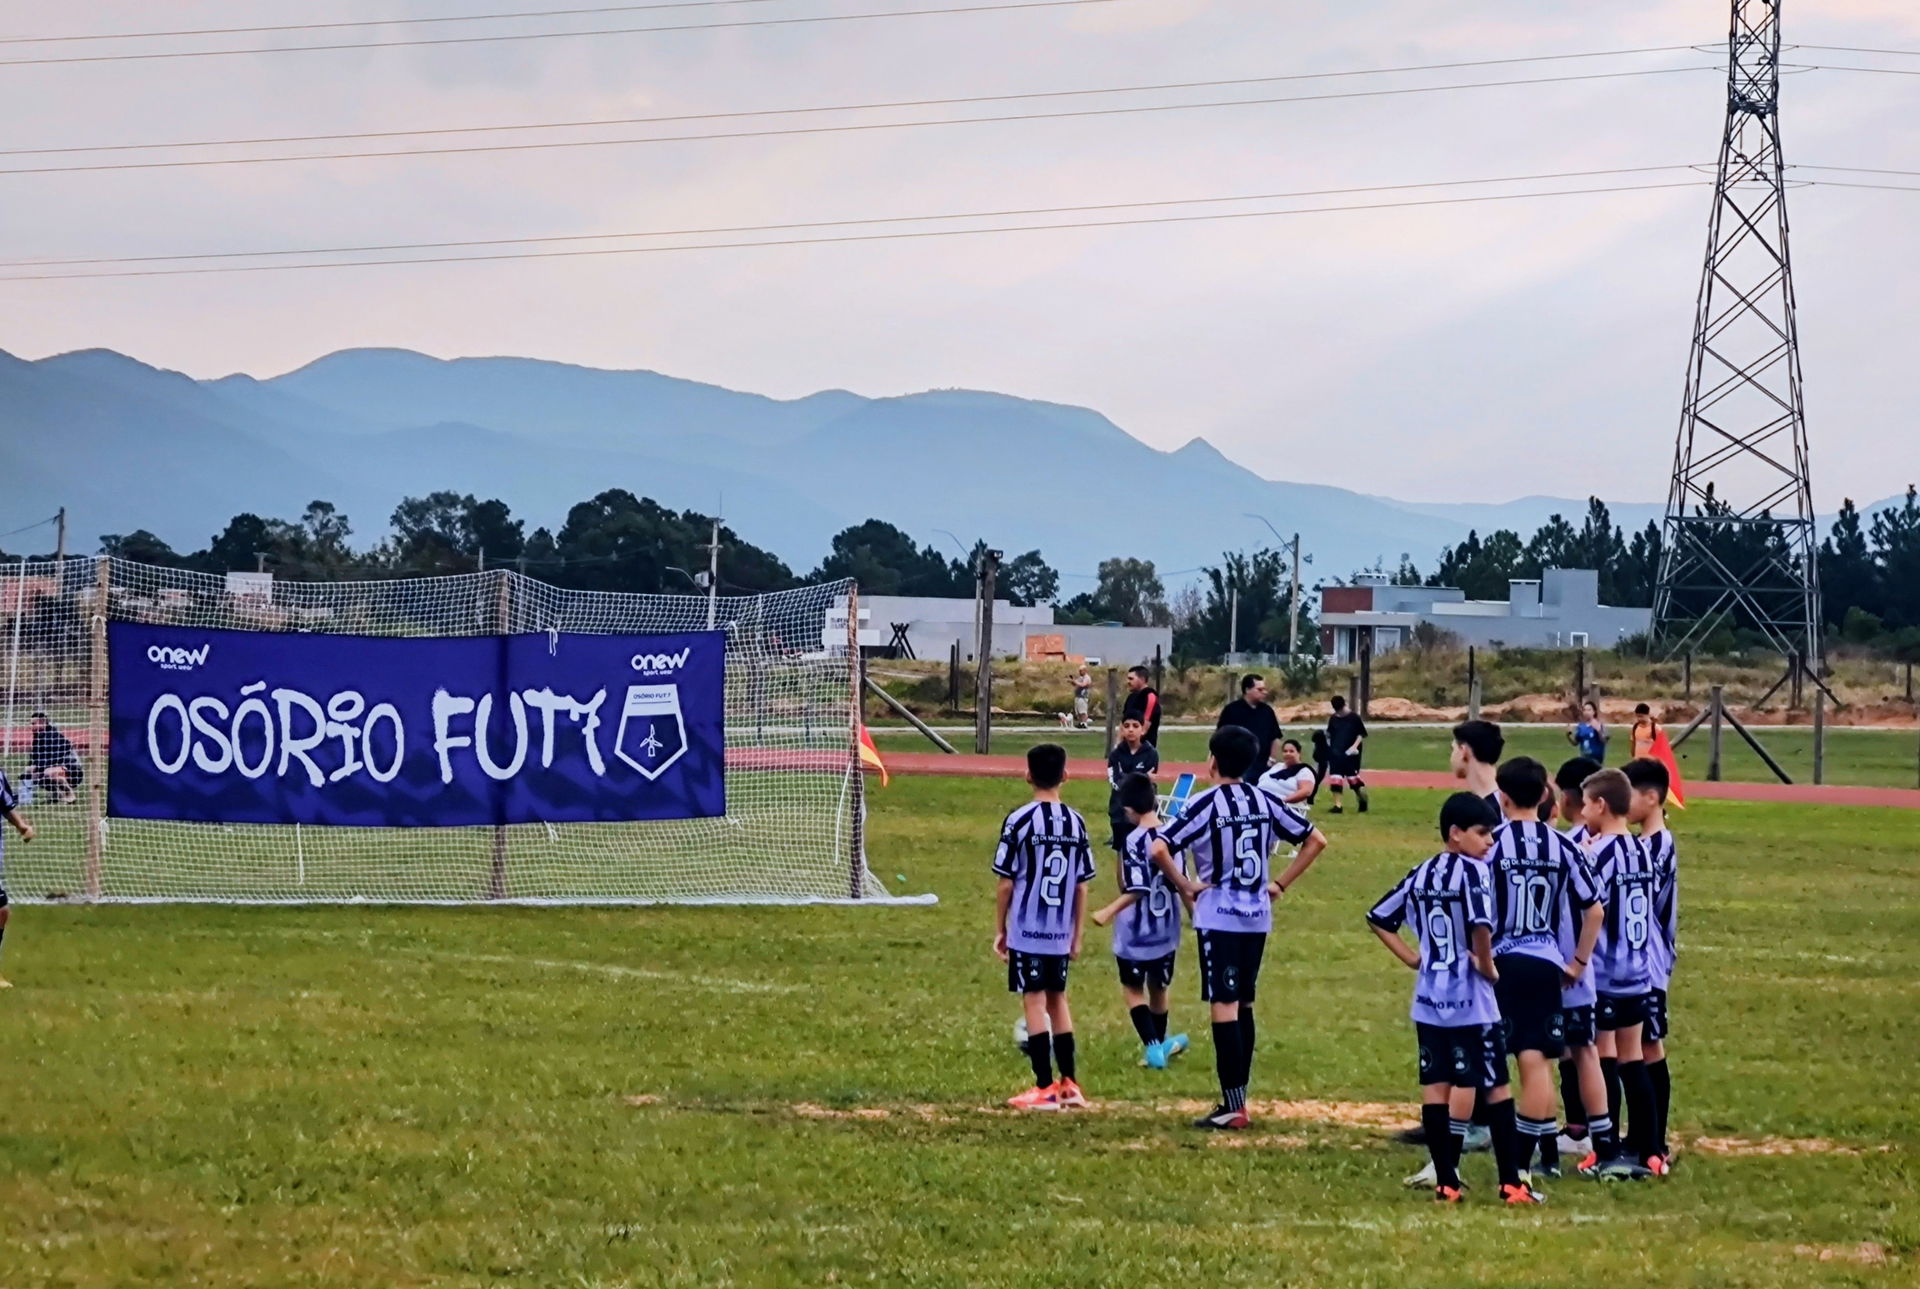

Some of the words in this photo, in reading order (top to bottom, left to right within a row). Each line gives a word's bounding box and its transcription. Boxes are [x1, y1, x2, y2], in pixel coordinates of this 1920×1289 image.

[147, 644, 210, 665] onew
[631, 647, 690, 670] onew
[633, 691, 655, 700] OSÓRIO
[1040, 848, 1068, 906] 2
[1234, 828, 1261, 886] 5
[1149, 870, 1172, 917] 6
[1511, 874, 1552, 937] 10
[1626, 887, 1648, 950] 8
[1428, 906, 1456, 971] 9
